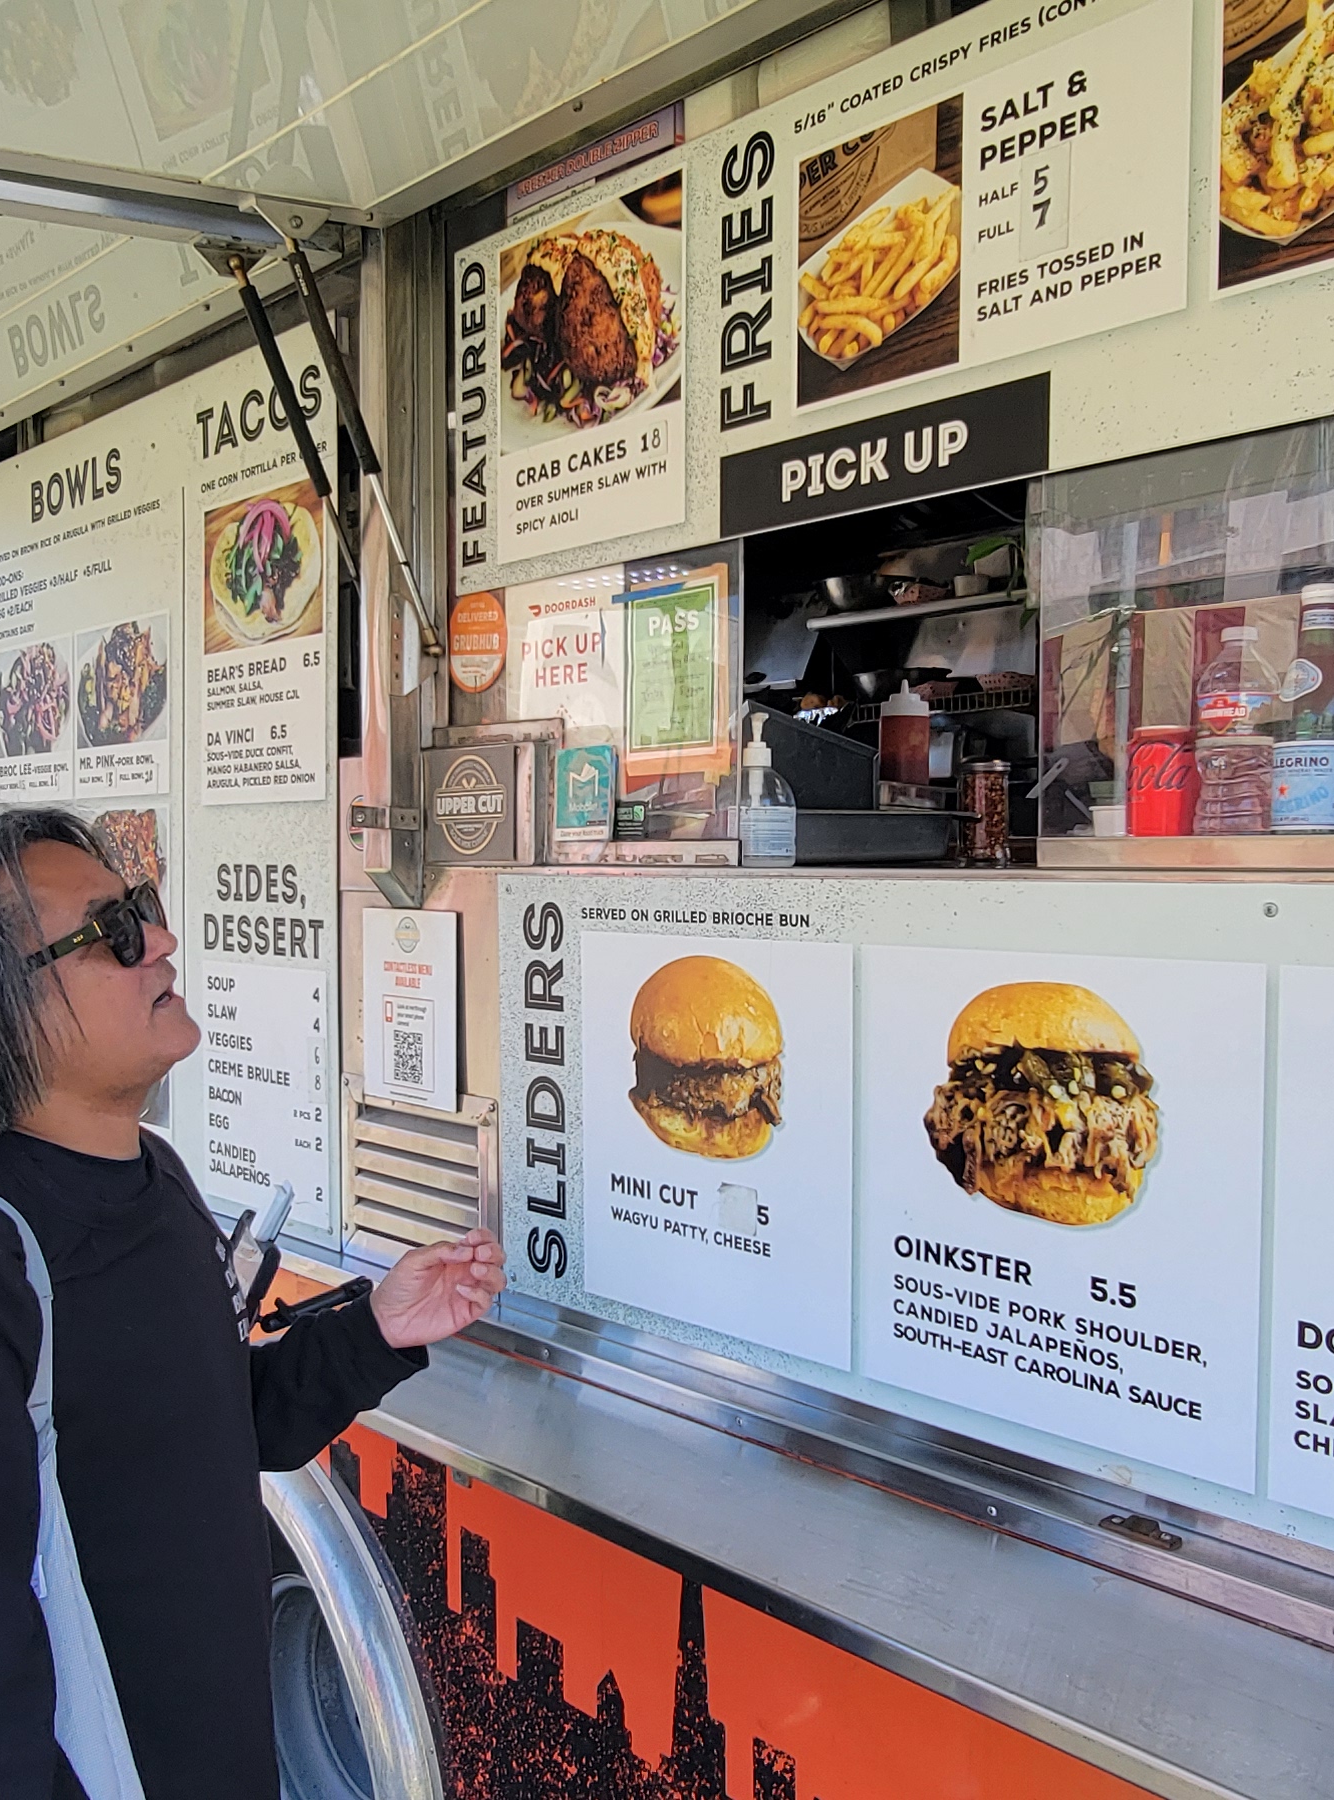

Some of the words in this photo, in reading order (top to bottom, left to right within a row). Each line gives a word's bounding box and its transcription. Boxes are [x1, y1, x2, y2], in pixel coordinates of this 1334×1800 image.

[794, 103, 834, 134] 5/16"
[840, 75, 903, 113] COATED
[910, 42, 972, 82] CRISPY
[979, 17, 1031, 53] FRIES
[981, 81, 1054, 132] SALT
[1067, 70, 1087, 97] &
[567, 144, 613, 176] DOUBLE
[613, 120, 659, 154] ZIPPER
[980, 105, 1099, 171] PEPPER
[979, 182, 1019, 207] HALF
[1033, 165, 1050, 197] 5
[978, 221, 1014, 243] FULL
[1032, 198, 1051, 230] 7
[720, 129, 775, 431] FRIES
[977, 269, 1028, 298] FRIES
[1037, 243, 1114, 279] TOSSED
[1124, 232, 1143, 253] IN
[977, 295, 1022, 321] SALT
[1029, 281, 1072, 306] AND
[1080, 253, 1162, 291] PEPPER
[462, 261, 489, 567] FEATURED
[201, 480, 215, 493] ONE
[218, 472, 238, 487] CORN
[241, 458, 278, 480] TORTILLA
[281, 452, 296, 466] PER
[516, 460, 560, 487] CRAB
[568, 440, 627, 473] CAKES
[641, 428, 661, 453] 18
[781, 439, 891, 502] PICK
[904, 421, 968, 475] UP
[31, 448, 121, 523] BOWLS
[516, 493, 543, 511] OVER
[548, 481, 593, 503] SUMMER
[598, 470, 630, 490] SLAW
[636, 461, 666, 480] WITH
[516, 517, 545, 534] SPICY
[550, 509, 579, 526] AIOLI
[457, 611, 498, 623] DELIVERED
[545, 597, 596, 614] DOORDASH
[649, 610, 699, 636] PASS
[454, 633, 499, 651] GRUBHUB
[522, 636, 567, 661] PICK
[576, 632, 602, 654] UP
[207, 664, 244, 683] BEAR'S
[249, 657, 287, 676] BREAD
[303, 651, 320, 667] 6.5
[535, 663, 588, 688] HERE
[207, 699, 235, 711] SUMMER
[260, 692, 283, 703] HOUSE
[1200, 706, 1247, 719] ARROWHEAD
[207, 732, 221, 746] DA
[225, 728, 254, 744] VINCI
[271, 725, 287, 740] 6.5
[207, 750, 243, 762] SOUS-VIDE
[245, 748, 264, 759] DUCK
[267, 745, 293, 756] CONFIT,
[207, 764, 231, 775] MANGO
[234, 761, 272, 773] HABANERO
[275, 759, 301, 770] SALSA,
[243, 776, 271, 786] PICKLED
[274, 775, 288, 784] RED
[291, 773, 315, 784] ONION
[437, 795, 476, 815] UPPER
[478, 794, 503, 813] CUT
[217, 864, 306, 909] SIDES,
[204, 914, 324, 959] DESSERT
[582, 908, 626, 921] SERVED
[631, 909, 648, 921] ON
[654, 910, 707, 924] GRILLED
[713, 912, 773, 926] BRIOCHE
[779, 914, 810, 927] BUN
[208, 976, 235, 992] SOUP
[313, 987, 320, 1003] 4
[208, 1004, 237, 1021] SLAW
[313, 1017, 320, 1033] 4
[208, 1031, 252, 1051] VEGGIES
[314, 1046, 320, 1065] 6
[208, 1059, 243, 1078] CREME
[247, 1065, 290, 1087] BRULEE
[315, 1075, 321, 1090] 8
[523, 901, 567, 1279] SLIDERS
[209, 1086, 242, 1106] BACON
[315, 1107, 322, 1122] 2
[209, 1112, 229, 1130] EGG
[315, 1137, 322, 1152] 2
[209, 1140, 256, 1163] CANDIED
[209, 1158, 270, 1187] JALAPEÑOS
[316, 1187, 322, 1202] 2
[611, 1173, 651, 1199] MINI
[659, 1184, 698, 1209] CUT
[611, 1206, 658, 1229] WAGYU
[664, 1219, 708, 1245] PATTY,
[714, 1231, 770, 1257] CHEESE
[894, 1235, 1032, 1286] OINKSTER
[1090, 1276, 1136, 1308] 5.5
[894, 1274, 1000, 1314] SOUS-VIDE
[1009, 1300, 1066, 1331] PORK
[1075, 1317, 1207, 1368] SHOULDER,
[894, 1299, 978, 1333] CANDIED
[986, 1323, 1123, 1375] JALAPEÑOS,
[894, 1323, 1008, 1367] SOUTH-EAST
[1015, 1355, 1121, 1398] CAROLINA
[1129, 1385, 1202, 1421] SAUCE
